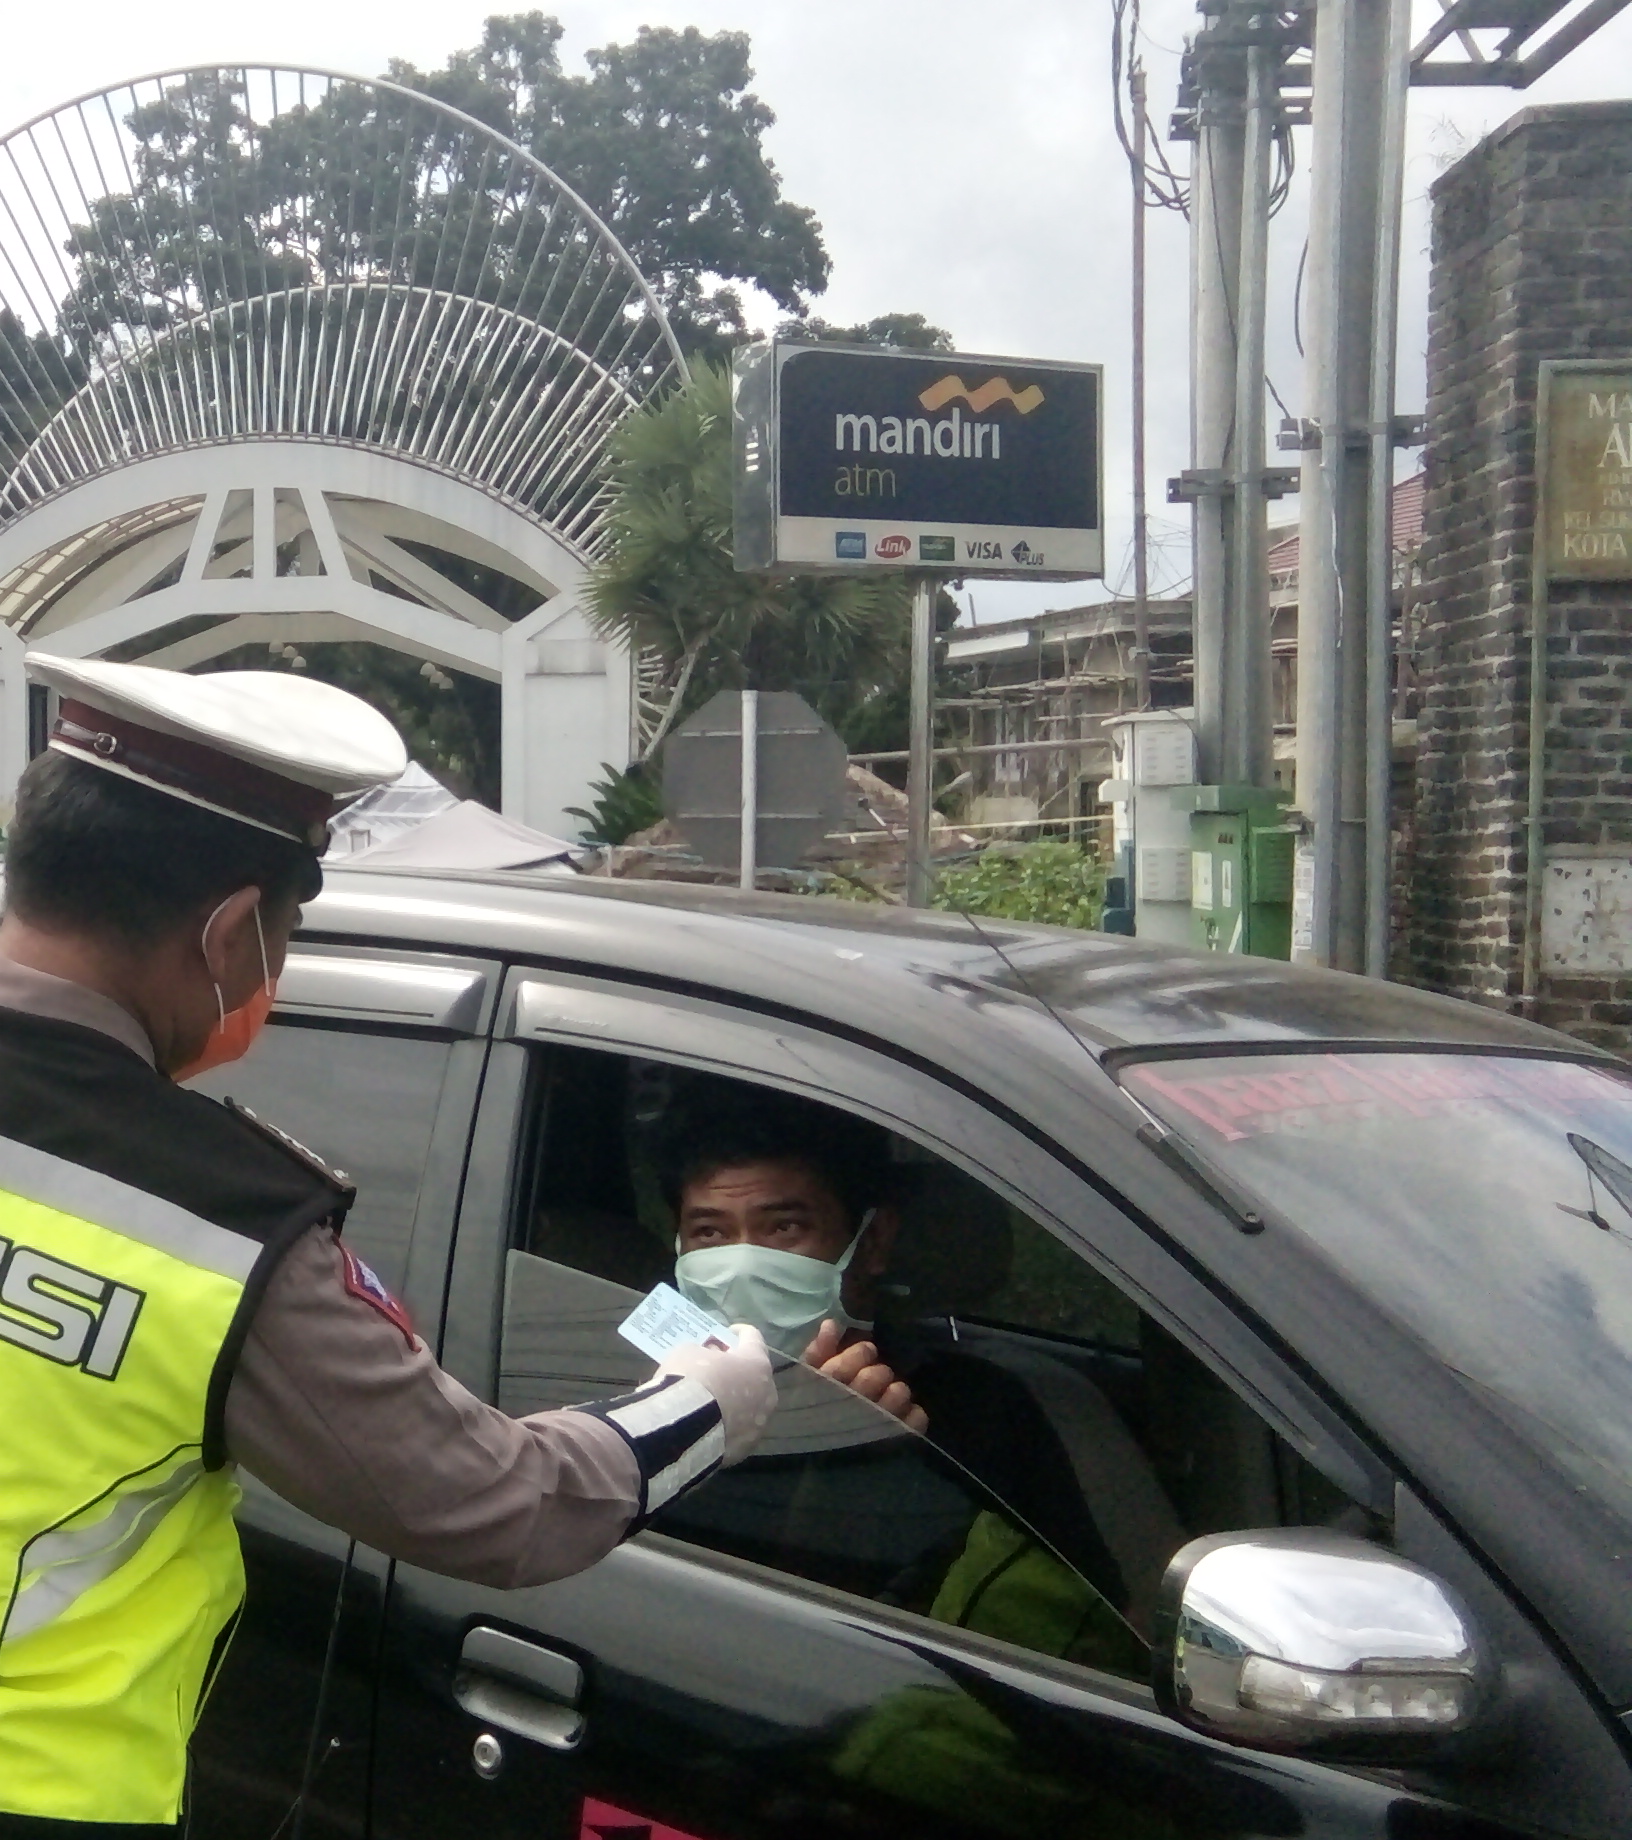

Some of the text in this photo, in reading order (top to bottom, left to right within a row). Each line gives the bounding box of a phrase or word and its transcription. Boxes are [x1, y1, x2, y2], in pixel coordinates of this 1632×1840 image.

[835, 406, 1001, 460] mandiri
[834, 463, 897, 498] atm
[876, 536, 908, 556] Link
[966, 540, 1003, 560] VISA
[1020, 550, 1045, 566] PLUS
[1563, 532, 1628, 560] KOTA
